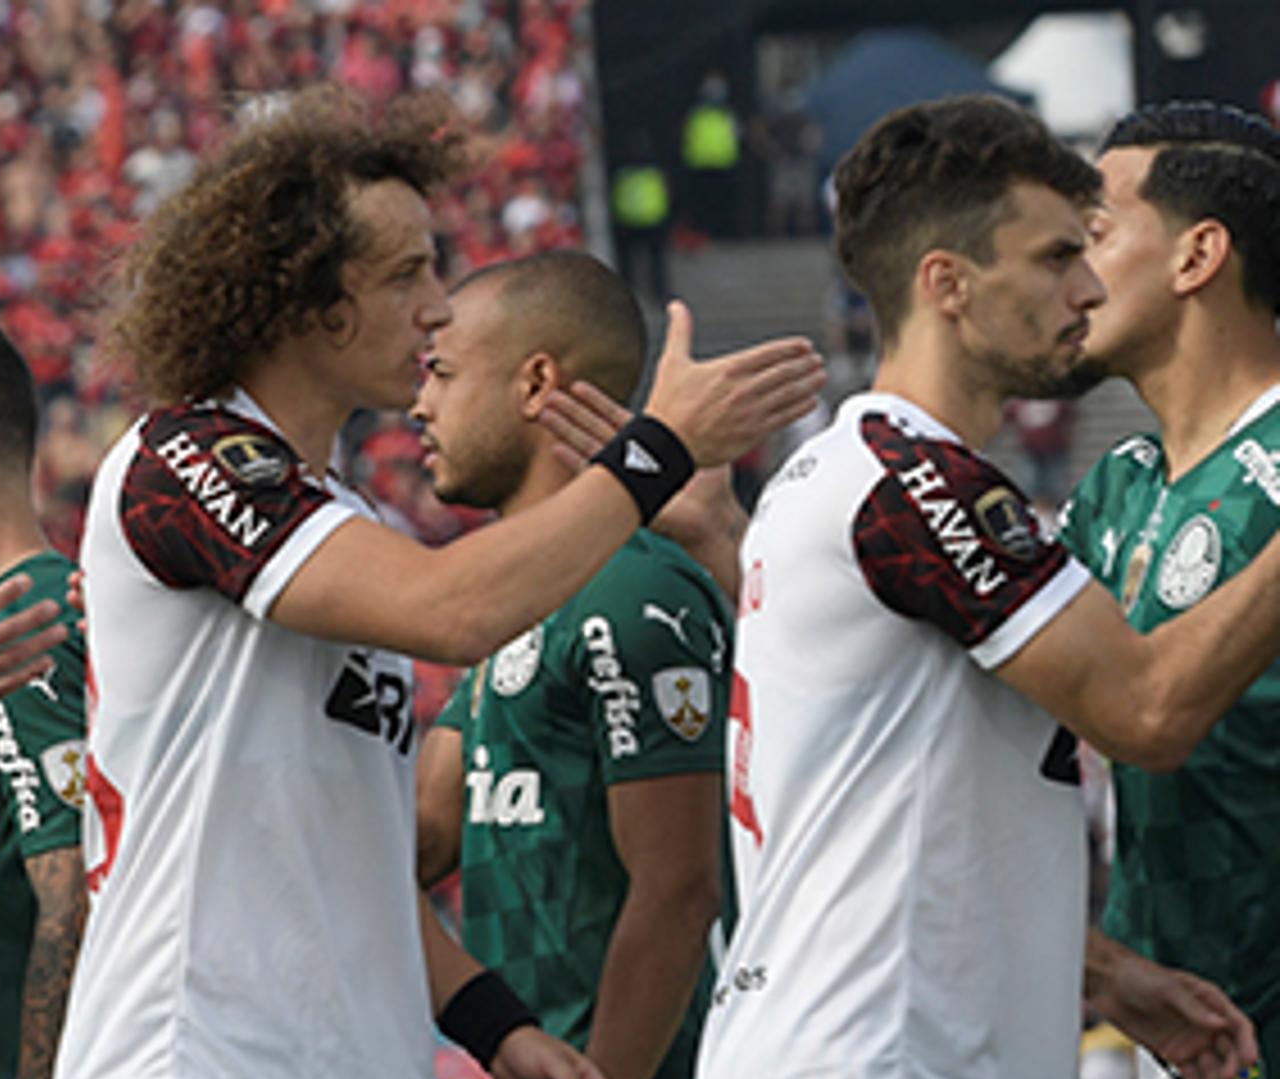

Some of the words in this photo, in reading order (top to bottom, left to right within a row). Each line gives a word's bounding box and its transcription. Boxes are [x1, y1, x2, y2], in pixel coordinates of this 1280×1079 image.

[154, 433, 268, 547] HAVAN
[897, 460, 1006, 595] HAVAN
[580, 616, 639, 759] crefisa
